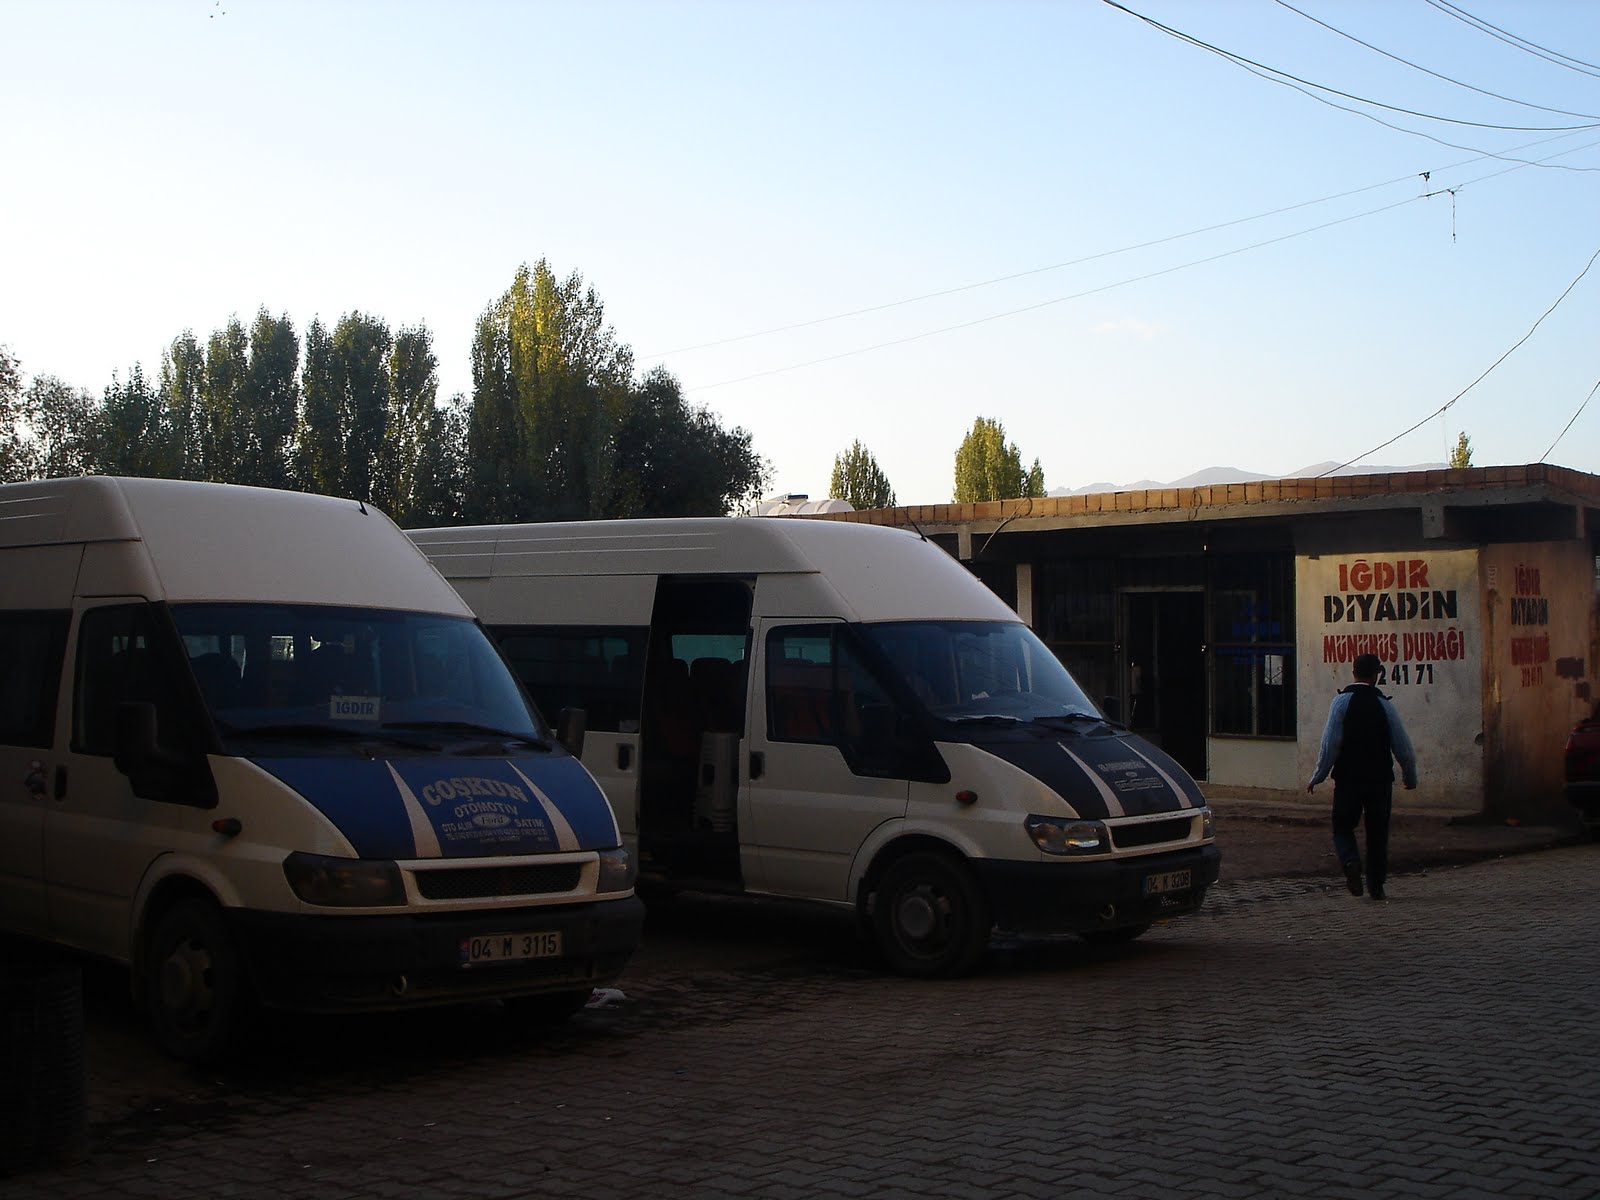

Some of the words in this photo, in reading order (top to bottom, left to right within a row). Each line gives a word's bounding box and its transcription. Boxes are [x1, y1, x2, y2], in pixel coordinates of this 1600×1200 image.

[1339, 559, 1430, 592] IĞDIR
[1403, 626, 1465, 662] DURAĞI
[1391, 664, 1409, 685] 41
[1416, 663, 1433, 685] 71
[422, 777, 529, 807] COŞKUN
[471, 938, 491, 959] 04
[503, 937, 512, 956] M
[522, 934, 557, 955] 3115
